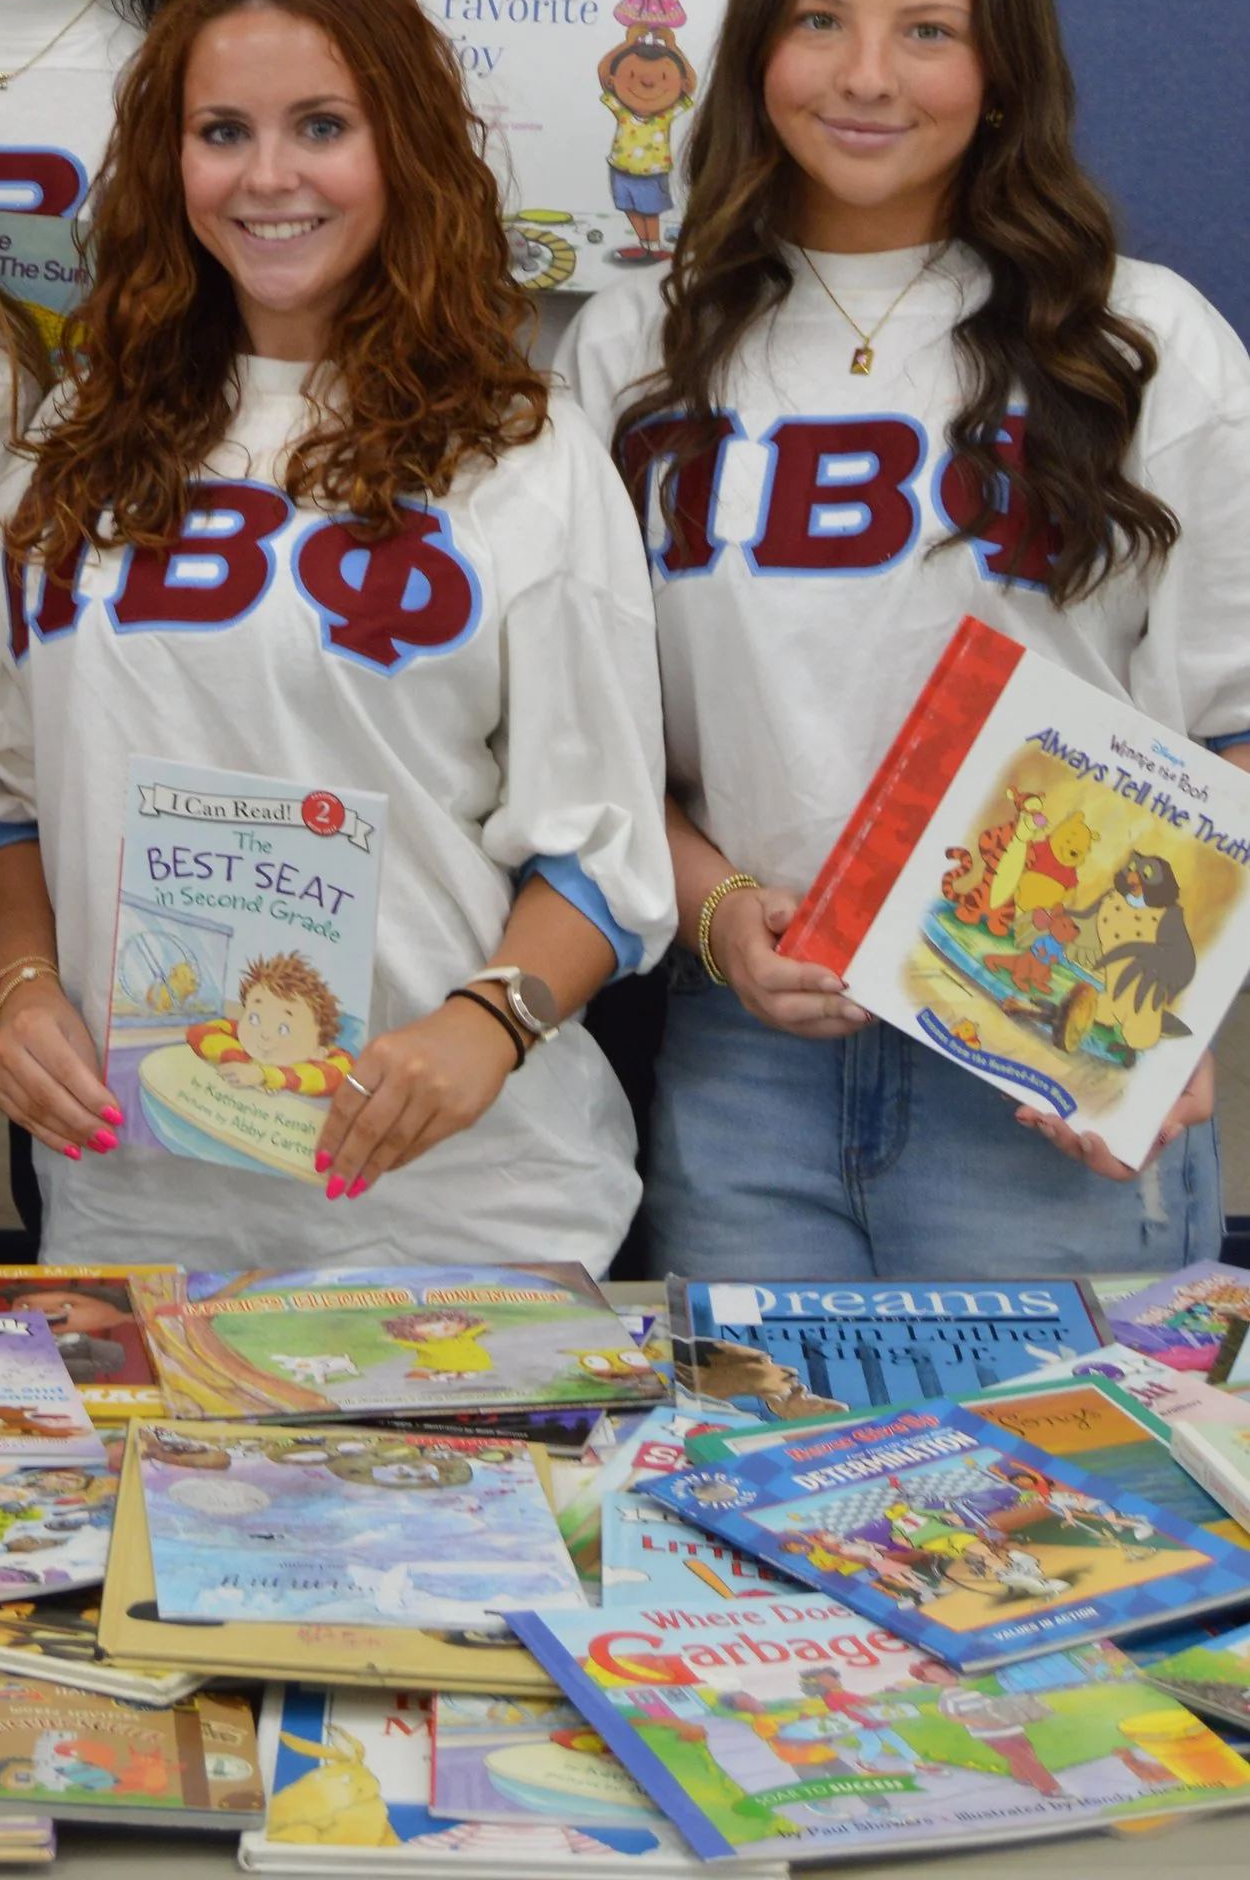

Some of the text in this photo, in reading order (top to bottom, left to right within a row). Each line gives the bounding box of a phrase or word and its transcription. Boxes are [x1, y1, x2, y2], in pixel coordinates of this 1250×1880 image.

[43, 259, 90, 285] Sun
[1025, 727, 1110, 783] Always
[1112, 765, 1153, 806] Tell
[1150, 791, 1191, 829] the
[1109, 733, 1210, 804] Winnie the Pooh
[171, 793, 331, 823] I Can Read! 2
[232, 829, 274, 855] The
[146, 846, 356, 916] BEST SEAT
[154, 886, 341, 945] in Second Grade
[231, 1115, 266, 1143] Abby
[719, 1321, 1070, 1343] Martin Luther
[791, 1430, 980, 1491] DETERMINATION
[640, 1606, 767, 1631] Where
[993, 1605, 1099, 1642] VALUES IN ACTION
[588, 1625, 914, 1686] Garbage
[829, 1777, 905, 1794] SUCCESS
[777, 1826, 801, 1841] by
[806, 1821, 848, 1838] Paul
[855, 1814, 934, 1834] Showers
[1048, 1796, 1074, 1815] by
